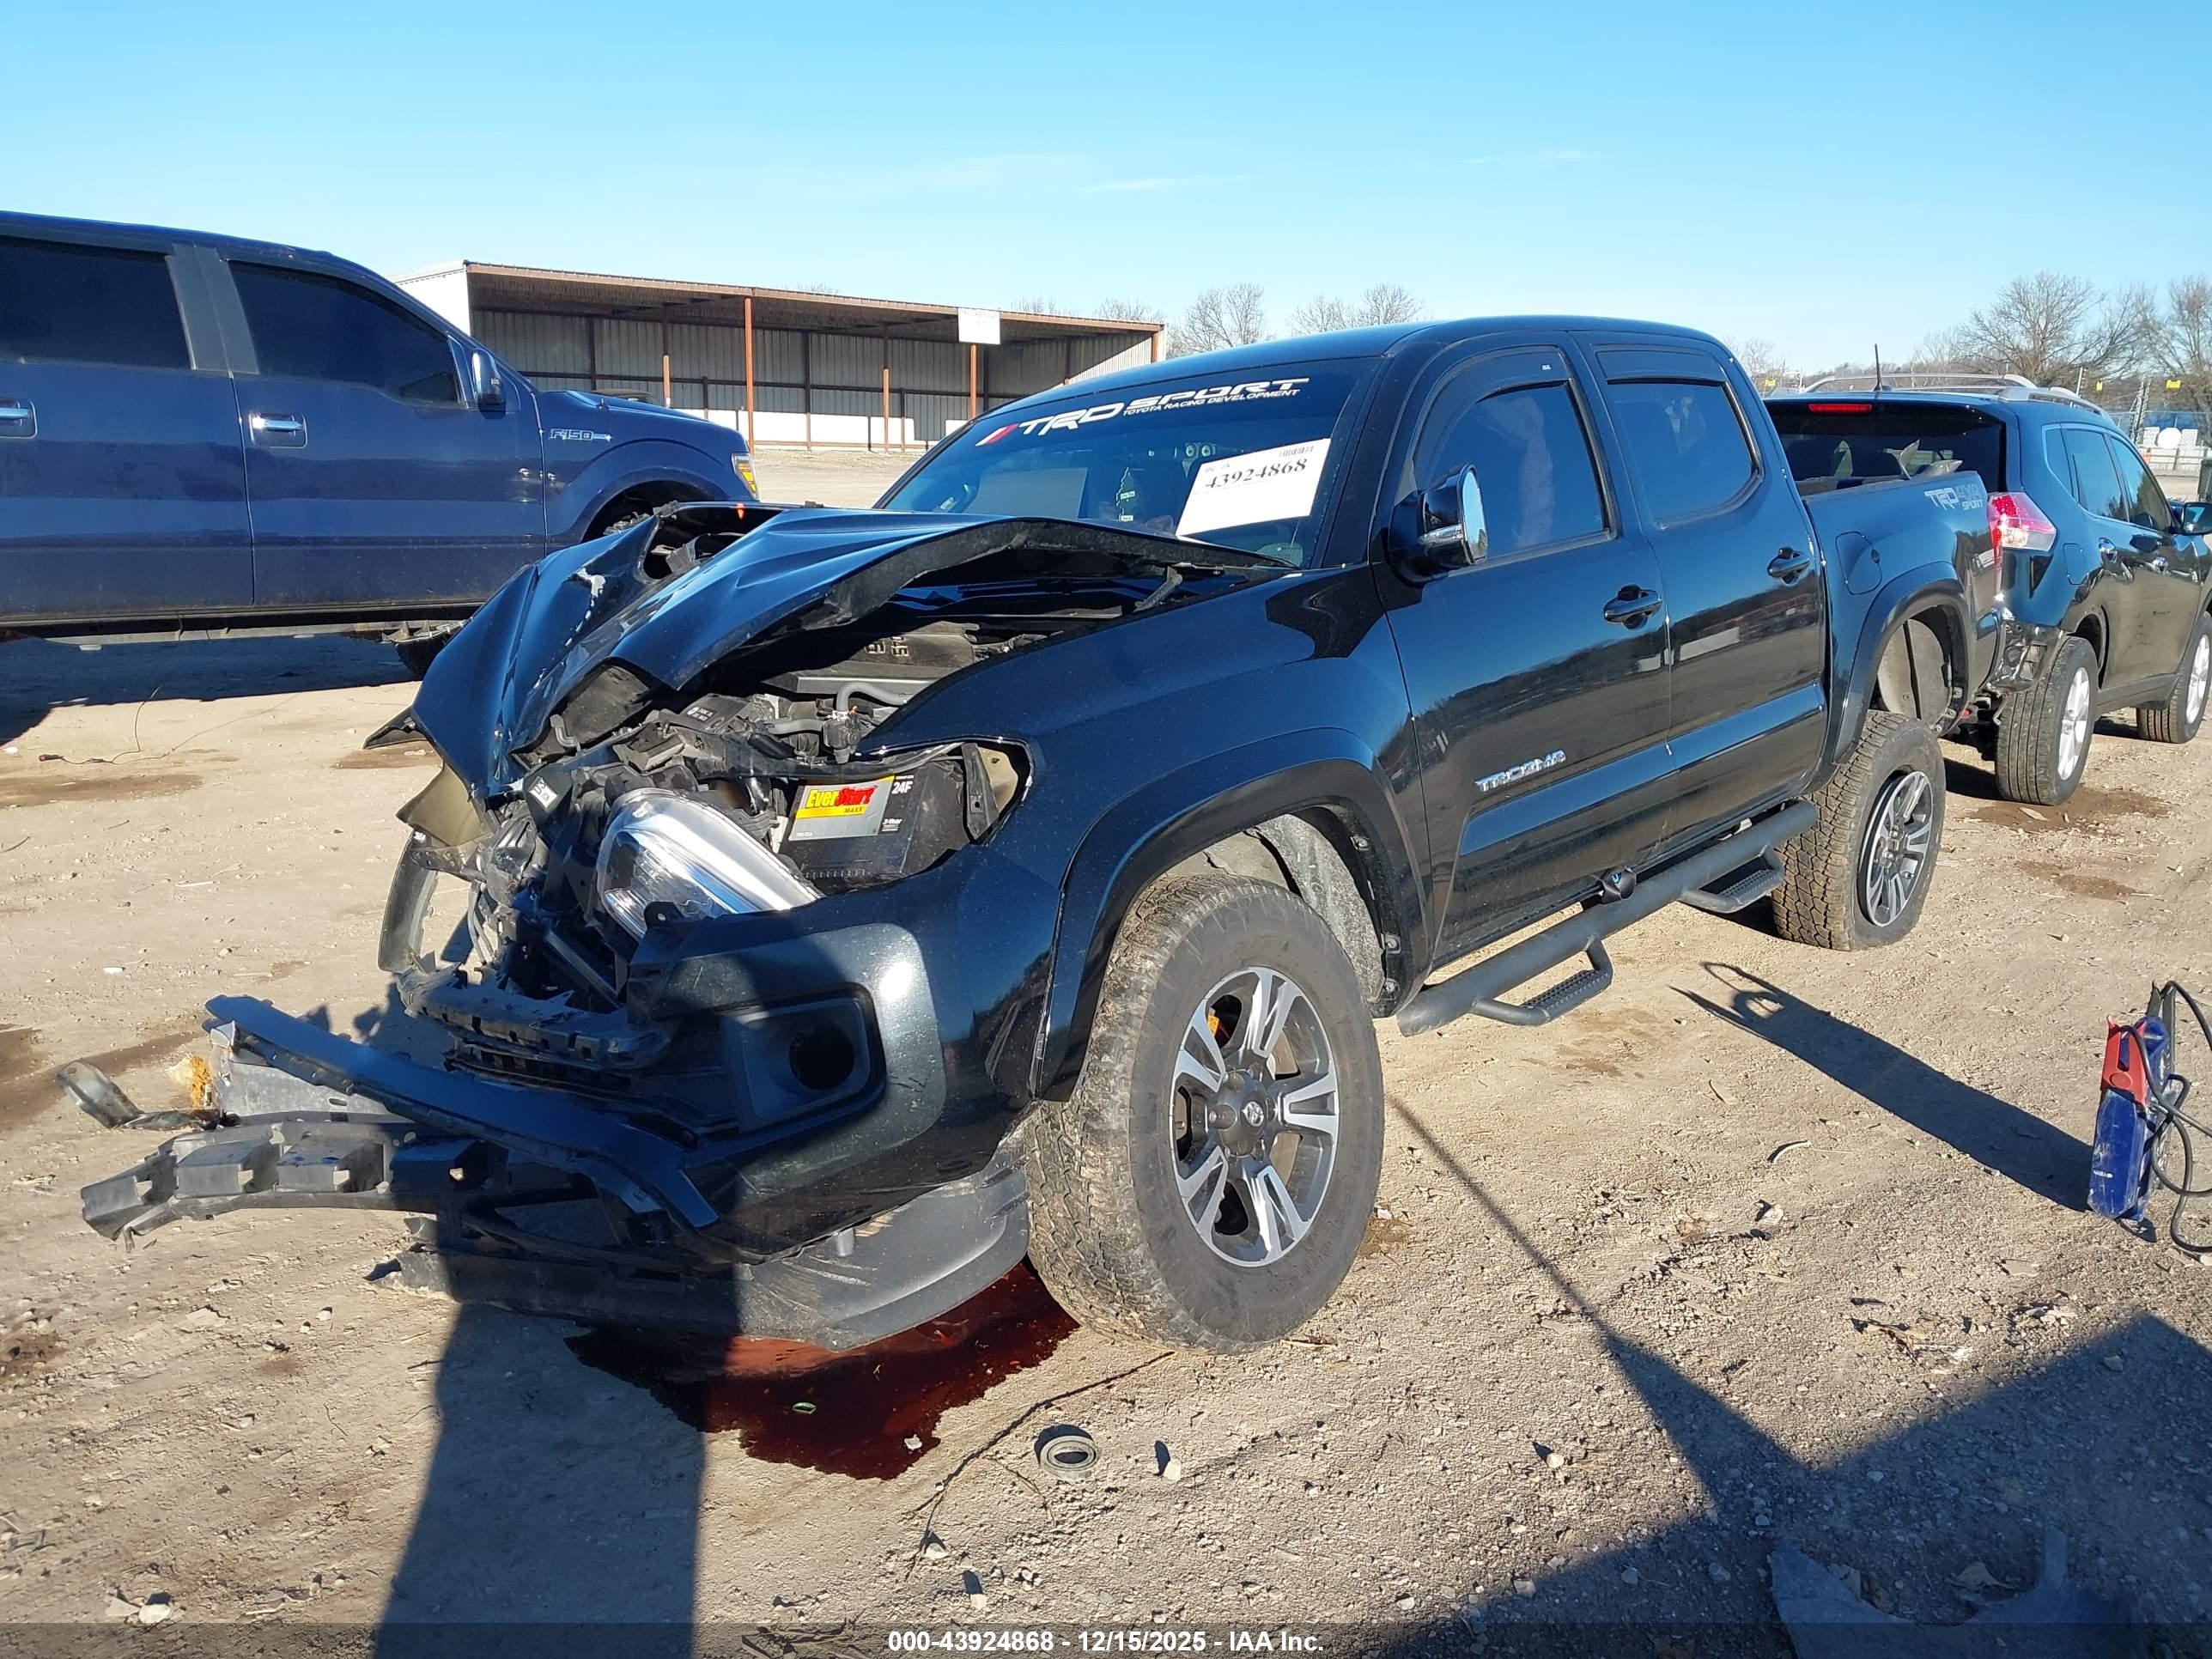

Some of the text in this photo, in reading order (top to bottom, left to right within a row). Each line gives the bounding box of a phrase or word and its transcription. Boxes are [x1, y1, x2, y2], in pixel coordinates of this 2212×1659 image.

[1019, 378, 1310, 435] TRD SPORT
[1123, 389, 1300, 416] TOYOTA RACING DEVELOPMENT
[1205, 458, 1309, 489] 43924868
[1924, 487, 1959, 511] TRD
[1961, 499, 1984, 511] SPORT
[1475, 749, 1567, 791] TACOMA
[890, 781, 914, 794] 24F
